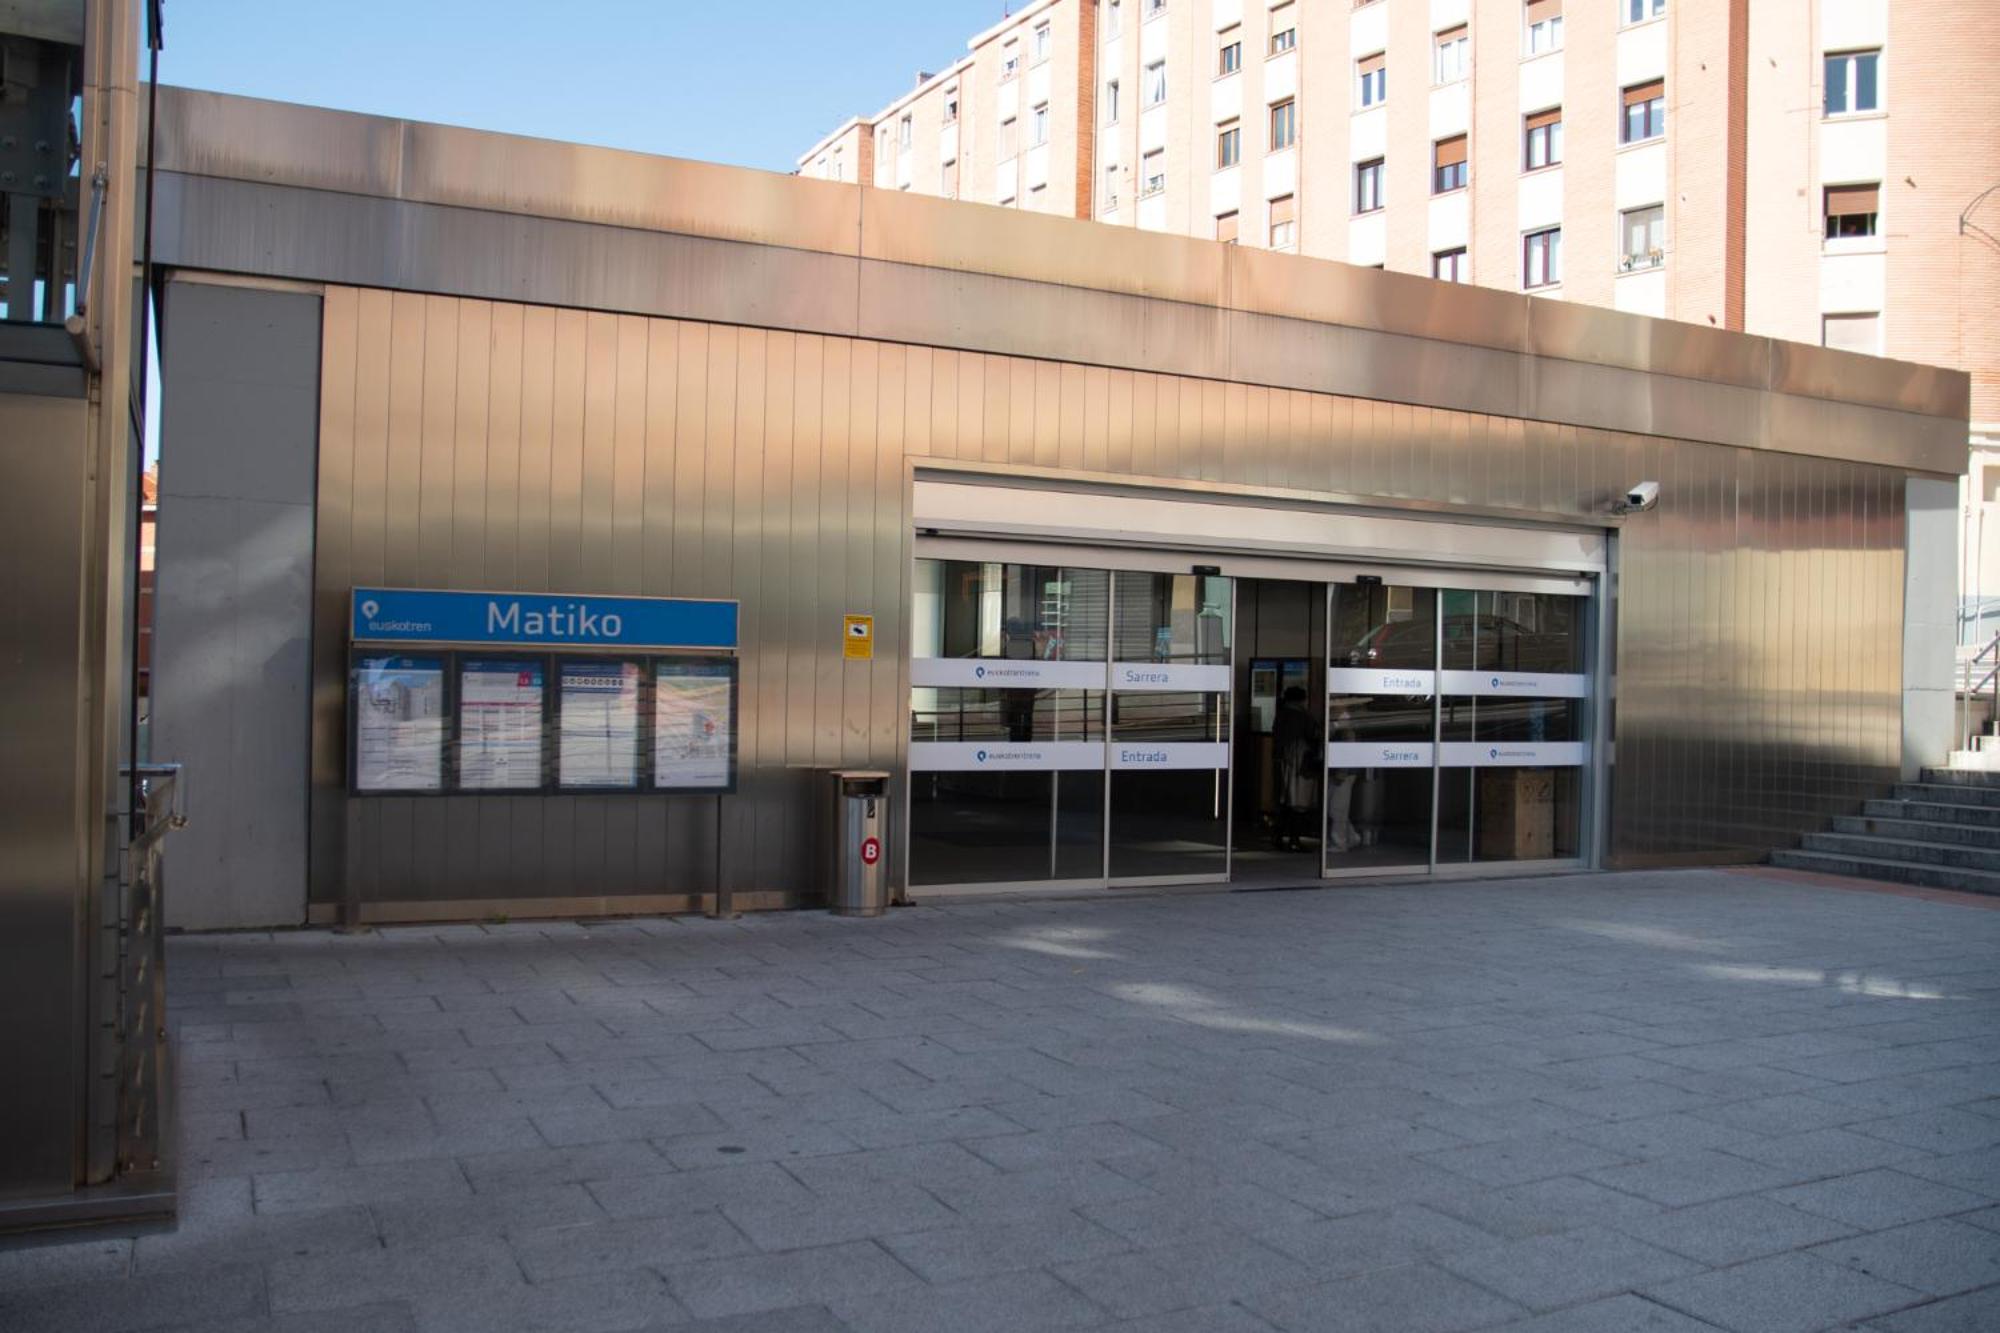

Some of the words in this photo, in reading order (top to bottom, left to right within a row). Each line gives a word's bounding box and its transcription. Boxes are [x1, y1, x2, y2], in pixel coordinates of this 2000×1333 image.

[487, 601, 623, 637] Matiko
[369, 620, 432, 632] euskotren
[1125, 670, 1169, 683] Sarrera
[1383, 676, 1421, 688] Entrada
[1121, 750, 1167, 763] Entrada
[1382, 750, 1419, 761] Sarrera
[865, 843, 877, 859] B
